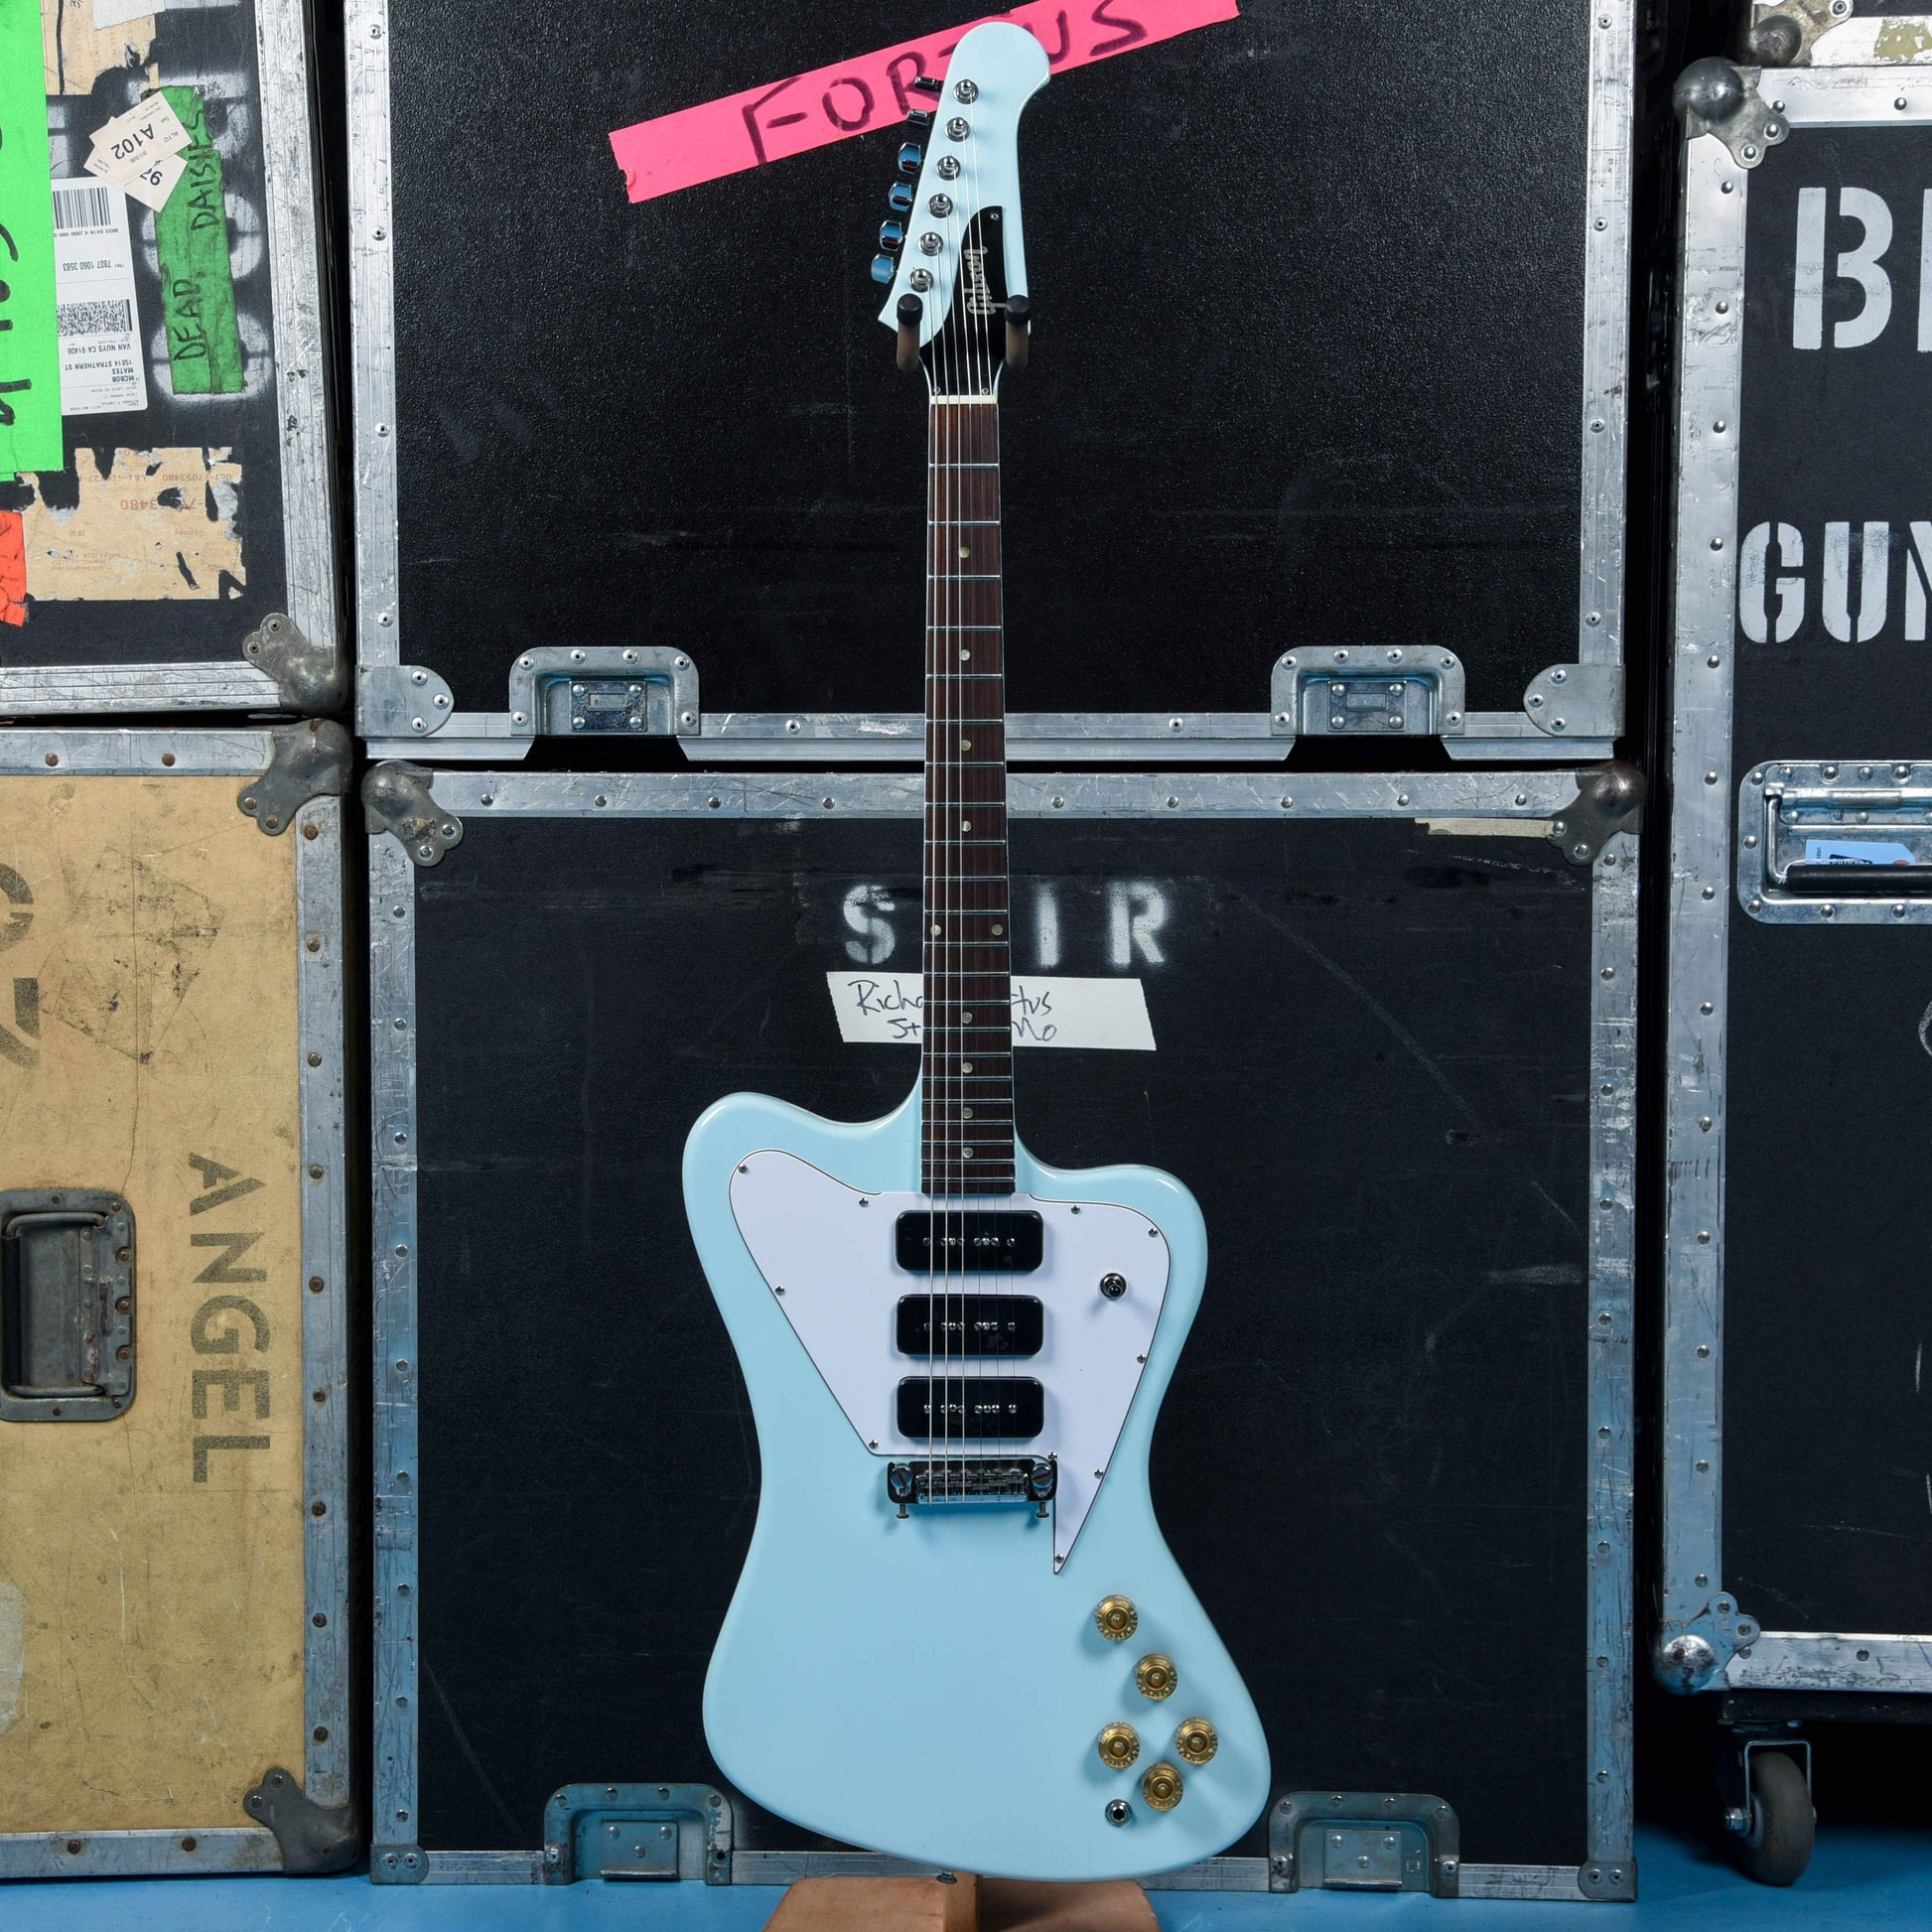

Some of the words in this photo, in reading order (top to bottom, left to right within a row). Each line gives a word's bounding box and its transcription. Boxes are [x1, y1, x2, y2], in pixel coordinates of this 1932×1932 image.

[742, 0, 1148, 164] FORUS
[110, 123, 154, 160] A102
[63, 262, 77, 272] 3583
[96, 259, 111, 269] 7807
[961, 245, 1007, 316] Gibson
[1793, 187, 1932, 351] B
[173, 279, 207, 361] DEAD
[74, 360, 112, 369] STRATHERN
[111, 366, 134, 375] MATES
[111, 374, 135, 383] MCBOB
[189, 1152, 271, 1483] ANGEL
